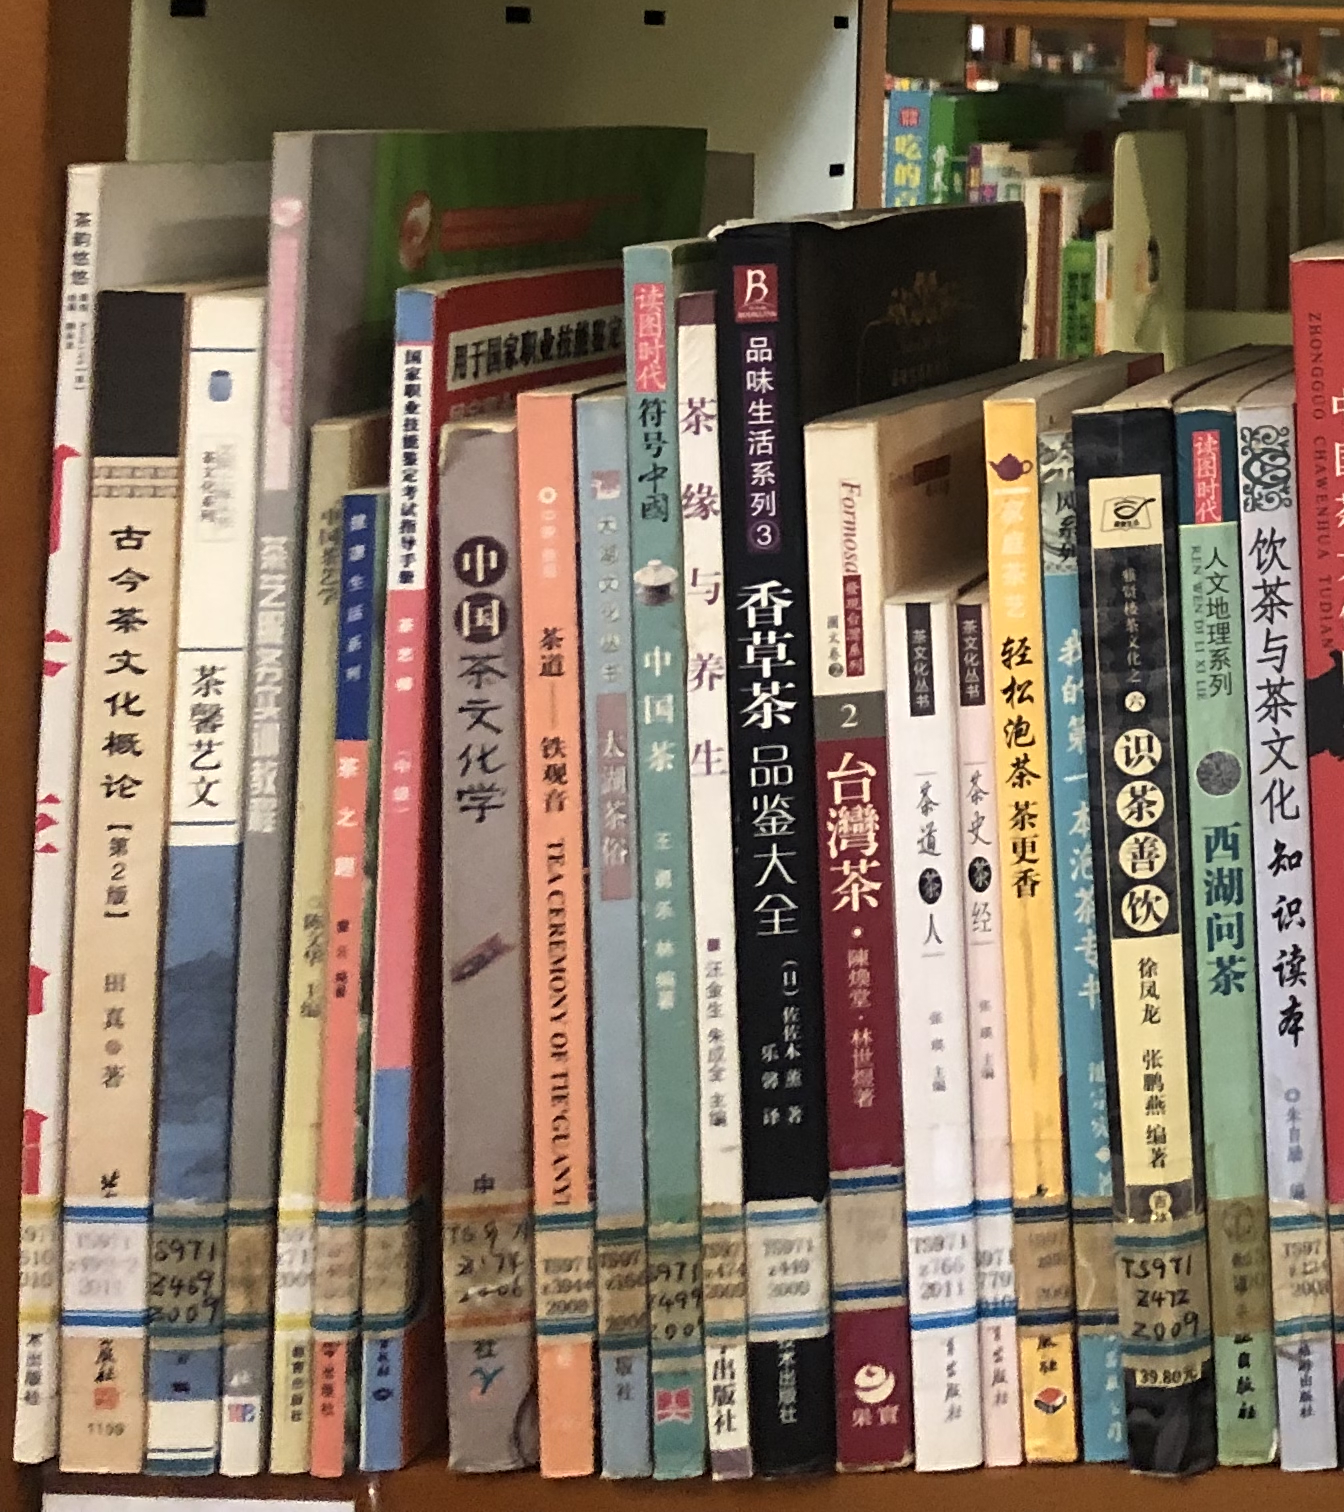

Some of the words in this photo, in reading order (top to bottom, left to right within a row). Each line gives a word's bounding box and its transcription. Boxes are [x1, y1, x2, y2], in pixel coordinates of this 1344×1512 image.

[635, 286, 666, 390] 读图时代
[1307, 312, 1325, 421] ZHONGGUO
[840, 480, 862, 575] Formosa
[1312, 436, 1330, 561] CHAWENHUA
[679, 397, 726, 778] 茶缘与养生
[1205, 546, 1232, 697] 人文地理系列
[1318, 577, 1335, 651] TUDIAN
[101, 525, 152, 801] 古今茶文化概论
[454, 535, 510, 823] 中国茶文化学
[643, 646, 676, 772] 中国茶
[912, 628, 932, 710] 茶文化丛书
[737, 581, 801, 937] 香草茶品鉴大全
[1000, 636, 1043, 898] 轻松泡茶茶更香
[1249, 527, 1309, 1046] 饮茶与茶文化知识读本
[1115, 729, 1171, 932] 识茶善饮
[546, 889, 569, 1023] CEREMONY
[1203, 822, 1249, 997] 西湖问茶
[1137, 956, 1162, 1025] 徐凤龙
